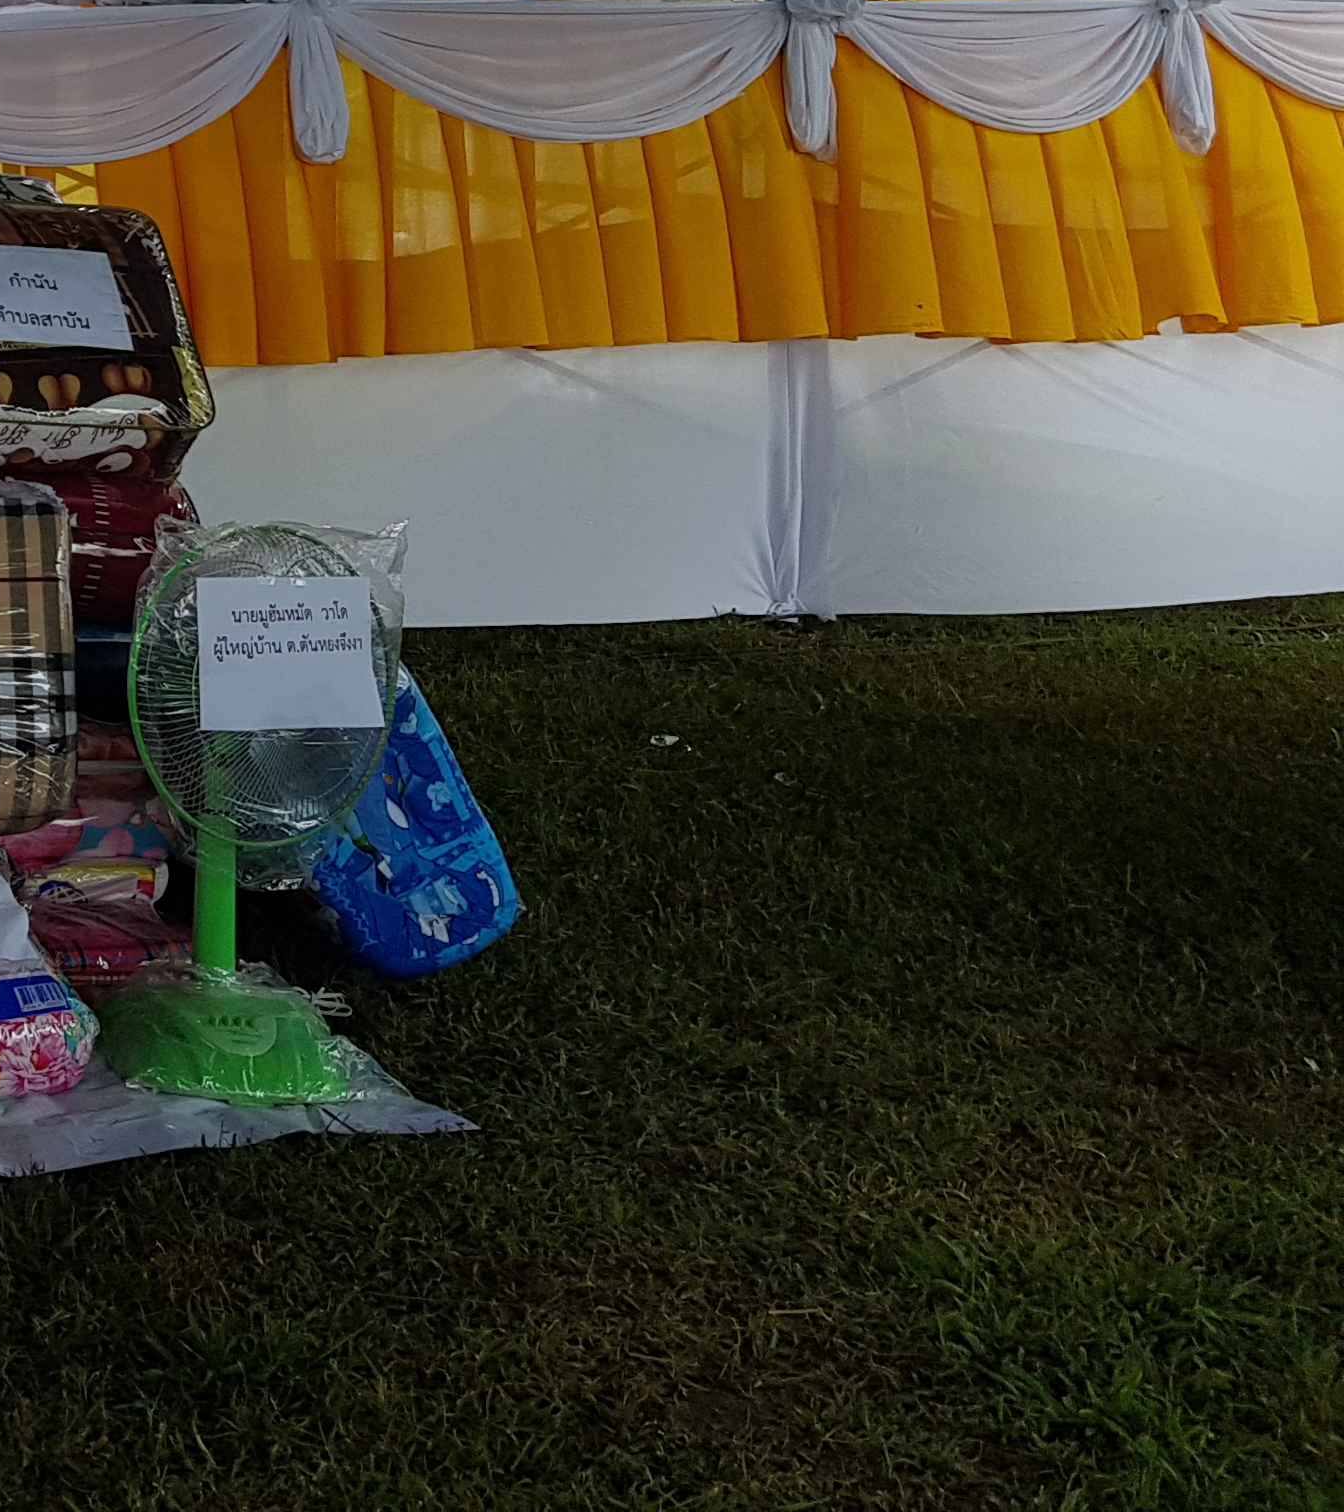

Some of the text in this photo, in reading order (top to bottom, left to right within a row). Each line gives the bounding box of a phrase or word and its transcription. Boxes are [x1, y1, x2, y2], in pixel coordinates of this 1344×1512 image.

[8, 272, 59, 291] กำนัน
[231, 602, 313, 629] นายมูฮัมหมัด
[213, 635, 282, 663] ผู้ใหญ่บ้าน
